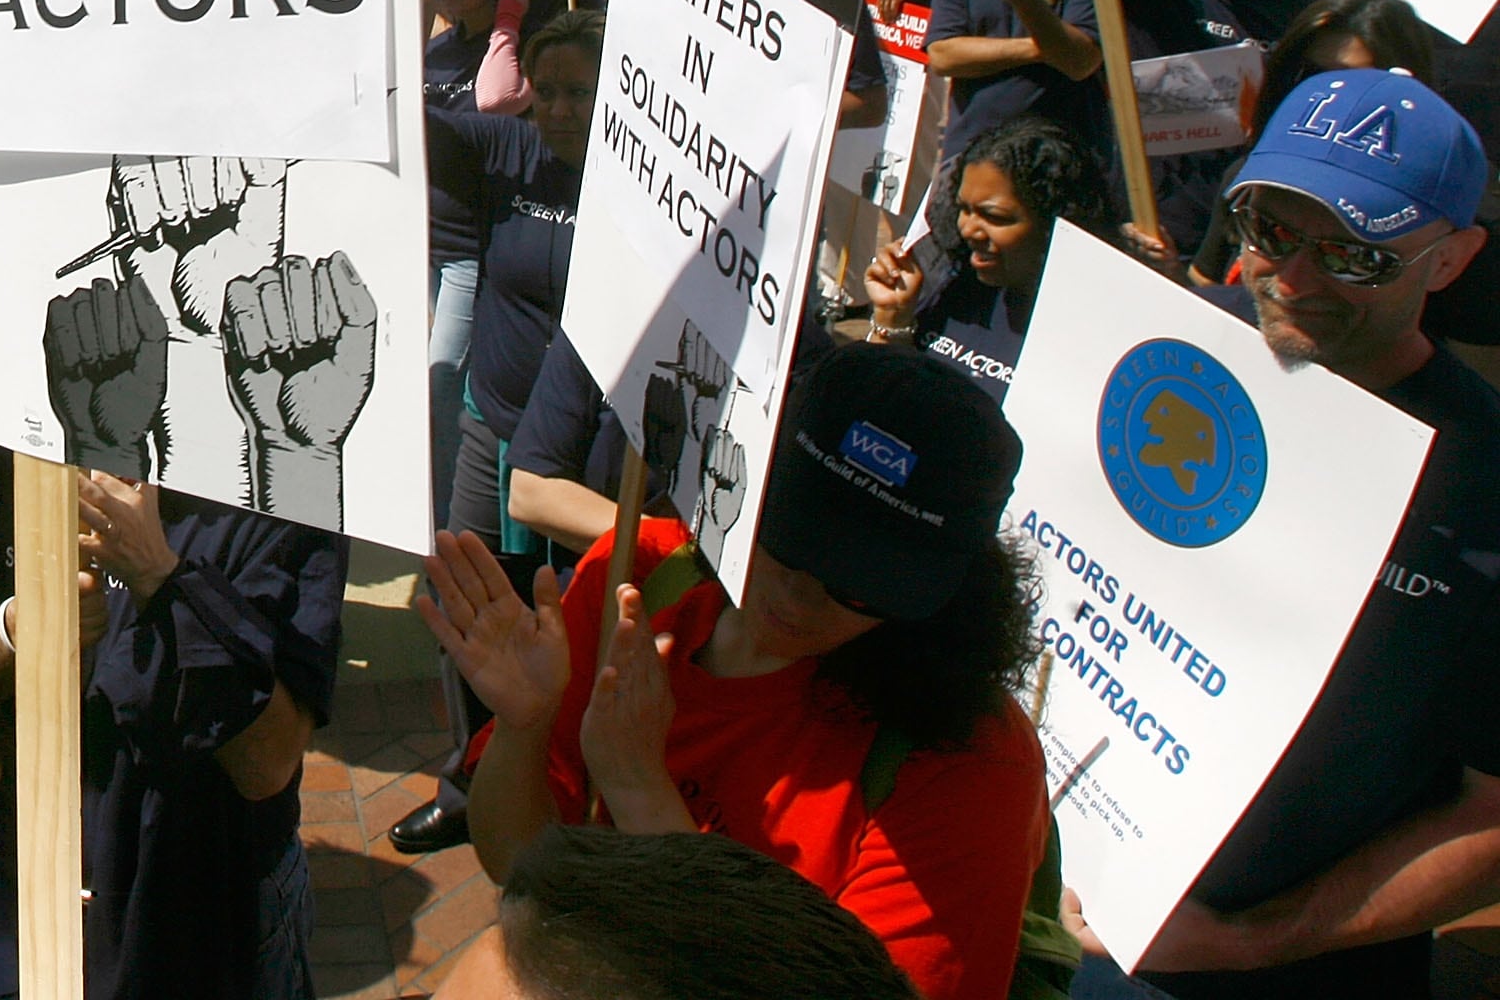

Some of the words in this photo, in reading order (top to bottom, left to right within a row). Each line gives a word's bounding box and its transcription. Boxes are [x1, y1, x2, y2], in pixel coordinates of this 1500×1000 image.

[681, 34, 715, 96] IN
[619, 53, 777, 231] SOLIDARITY
[1187, 127, 1220, 138] HELL
[1287, 92, 1401, 165] LA
[511, 194, 565, 223] SCREEN
[604, 102, 657, 196] WITH
[657, 173, 780, 327] ACTORS
[1337, 198, 1365, 227] LOS
[1366, 204, 1419, 233] ANGELES
[851, 429, 909, 476] WGA
[1105, 350, 1180, 429] SCREEN
[1213, 382, 1259, 518] ACTORS
[822, 455, 852, 481] Guild
[853, 475, 870, 488] of
[868, 483, 920, 518] America,
[1020, 509, 1120, 604] ACTORS
[1122, 592, 1227, 699] UNITED
[1074, 599, 1129, 664] FOR
[1040, 617, 1191, 776] CONTRACTS
[1080, 786, 1090, 800] to
[1090, 800, 1111, 823] pick
[1111, 822, 1125, 842] up,
[1091, 779, 1102, 793] to
[1102, 792, 1132, 826] refuse
[1132, 824, 1143, 839] to
